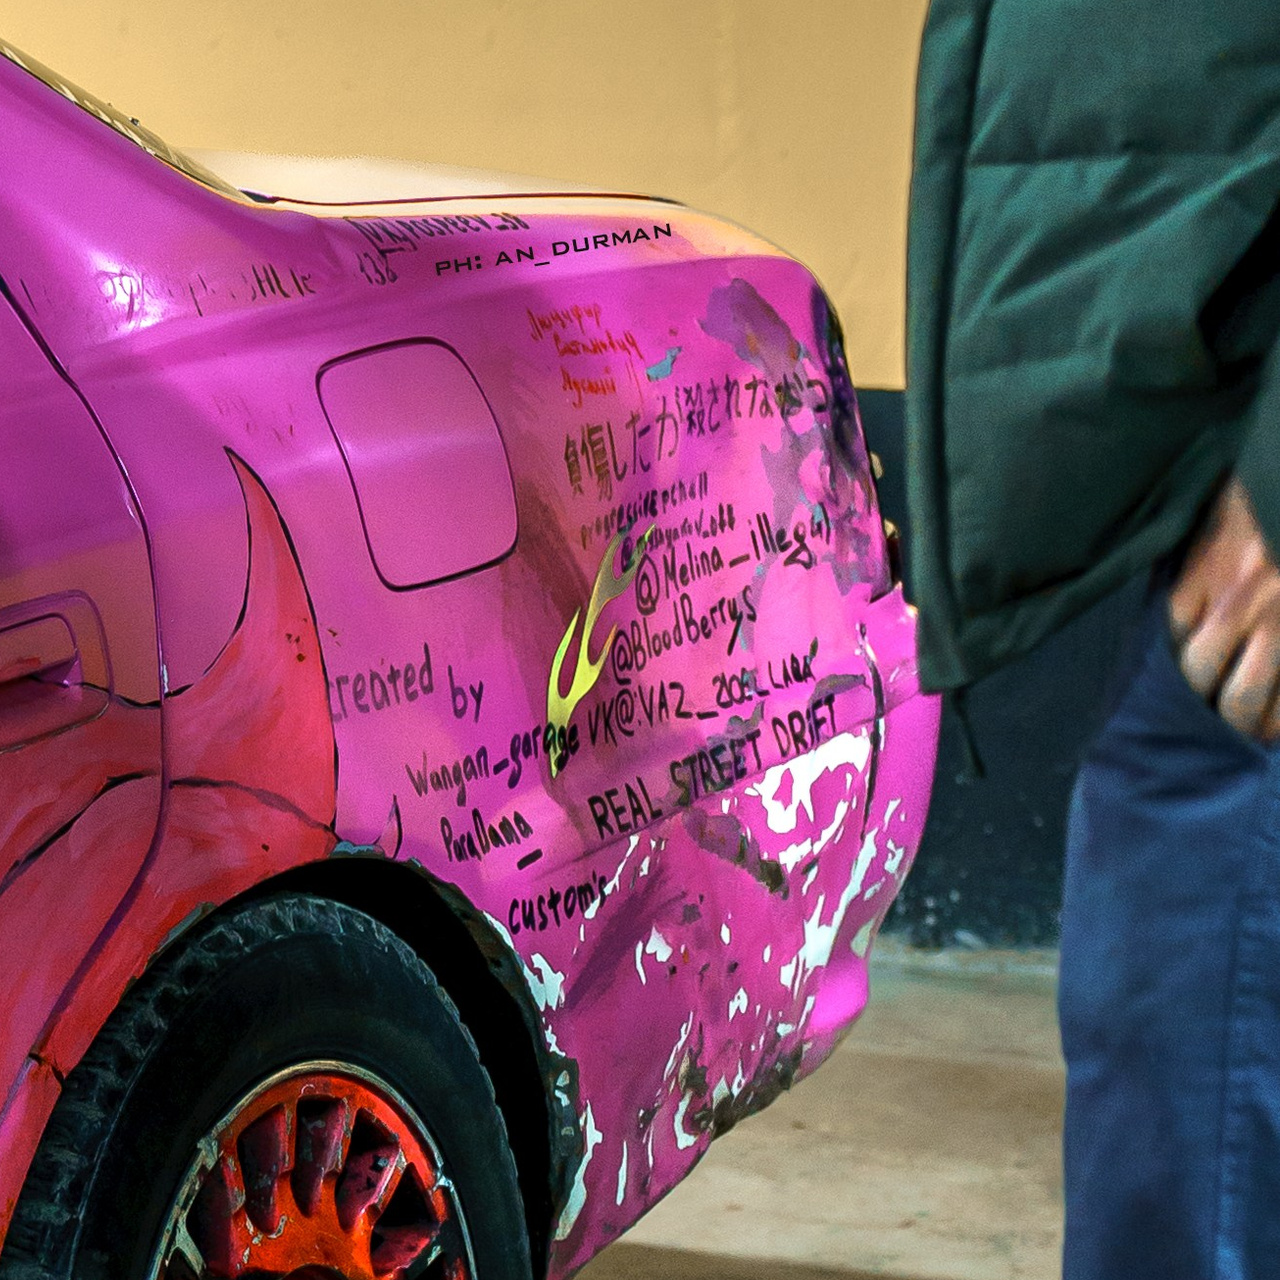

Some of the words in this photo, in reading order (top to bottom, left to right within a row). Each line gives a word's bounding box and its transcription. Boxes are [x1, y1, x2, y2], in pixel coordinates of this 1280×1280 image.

[435, 257, 482, 277] PH:
[494, 224, 673, 268] AN_DURMAN
[447, 664, 484, 723] by
[587, 775, 663, 841] REAL
[669, 728, 762, 808] STREET
[771, 693, 838, 758] DRIFT
